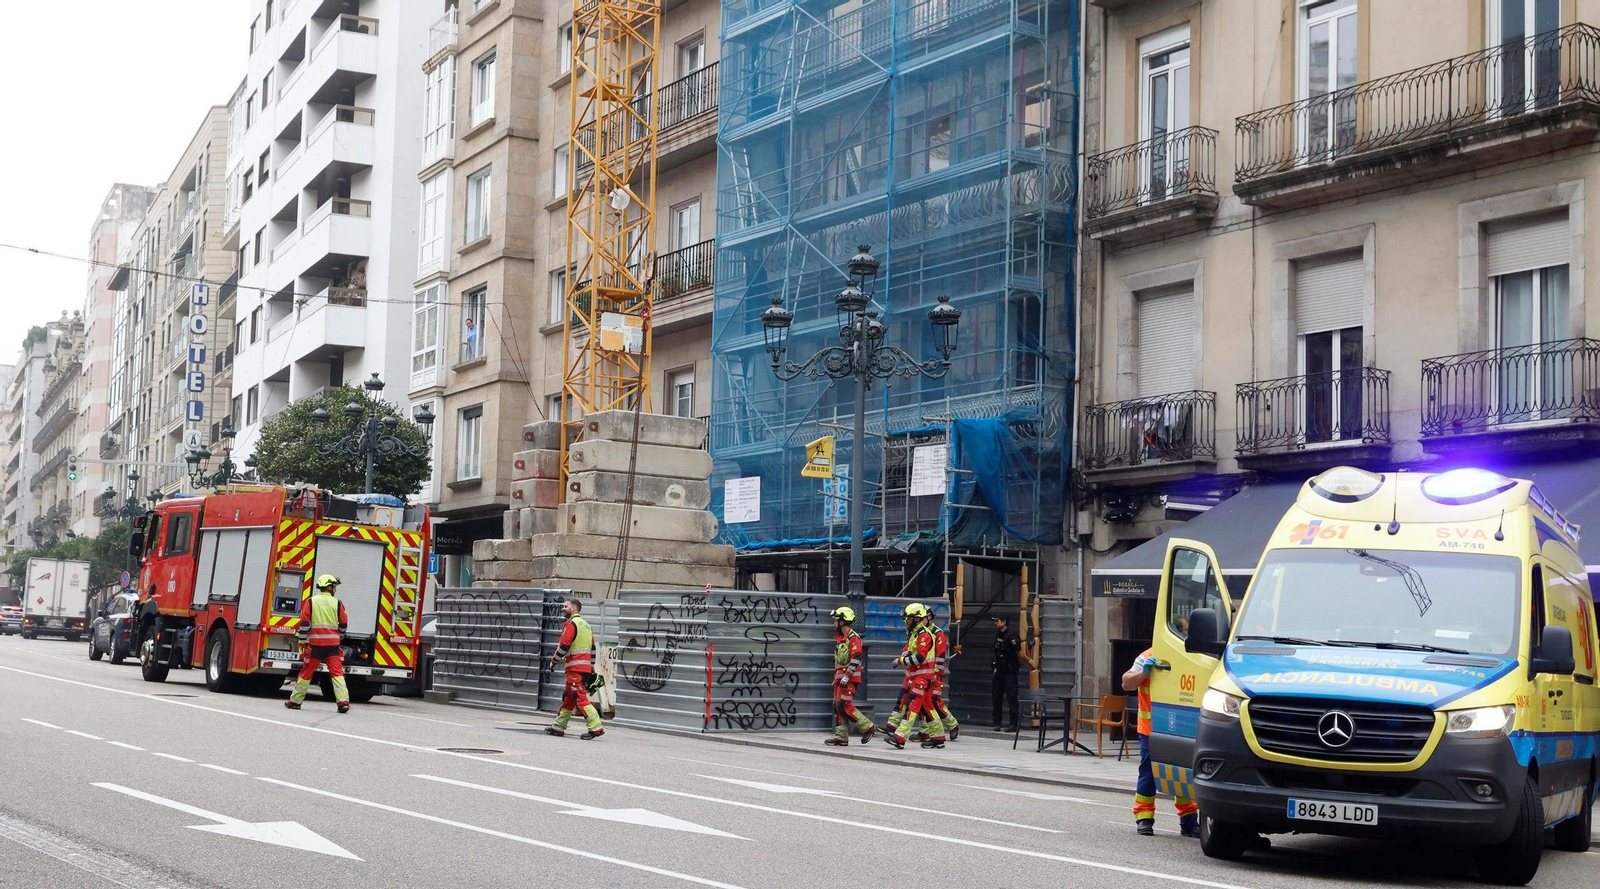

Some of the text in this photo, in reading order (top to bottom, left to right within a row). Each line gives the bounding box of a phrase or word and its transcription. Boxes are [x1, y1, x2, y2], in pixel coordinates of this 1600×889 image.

[188, 285, 208, 421] HOTEL
[1436, 527, 1488, 540] SVA
[1438, 541, 1485, 550] AM-746
[270, 651, 285, 659] 1533
[608, 648, 618, 660] 20
[1181, 674, 1195, 691] 061
[1298, 803, 1374, 822] 8843 LDD
